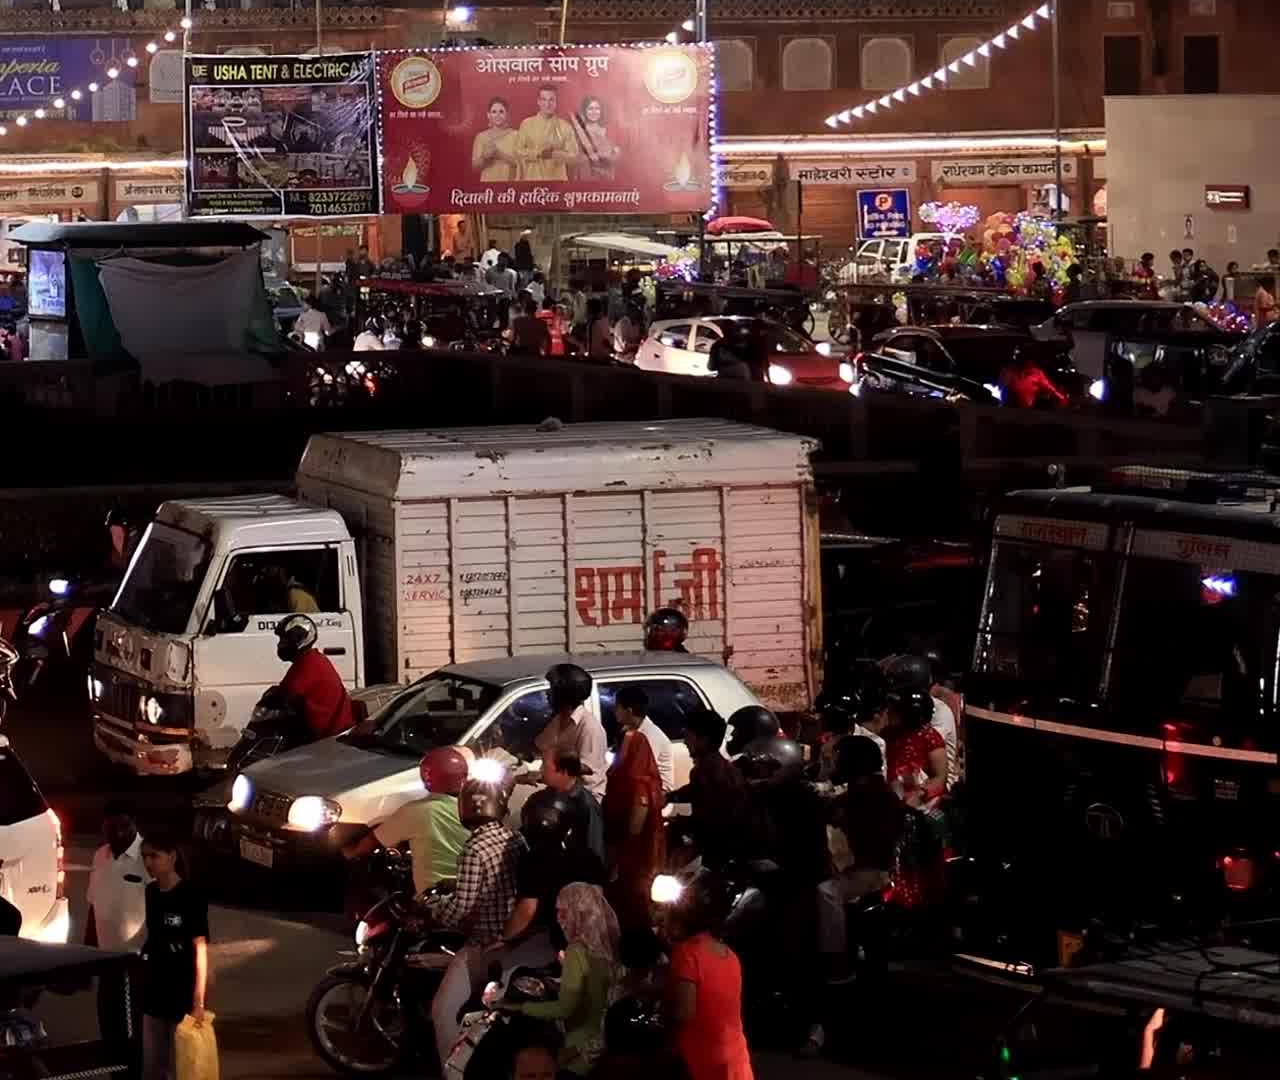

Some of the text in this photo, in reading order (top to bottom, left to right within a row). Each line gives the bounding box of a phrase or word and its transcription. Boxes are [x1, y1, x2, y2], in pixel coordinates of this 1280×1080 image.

[214, 65, 247, 80] USHA
[250, 64, 278, 80] TENT
[280, 65, 290, 79] &
[477, 55, 609, 76] ओसवाल सोप ग्रुप
[451, 189, 493, 206] दिवाली
[497, 188, 516, 205] की
[519, 186, 559, 205] हार्दिक
